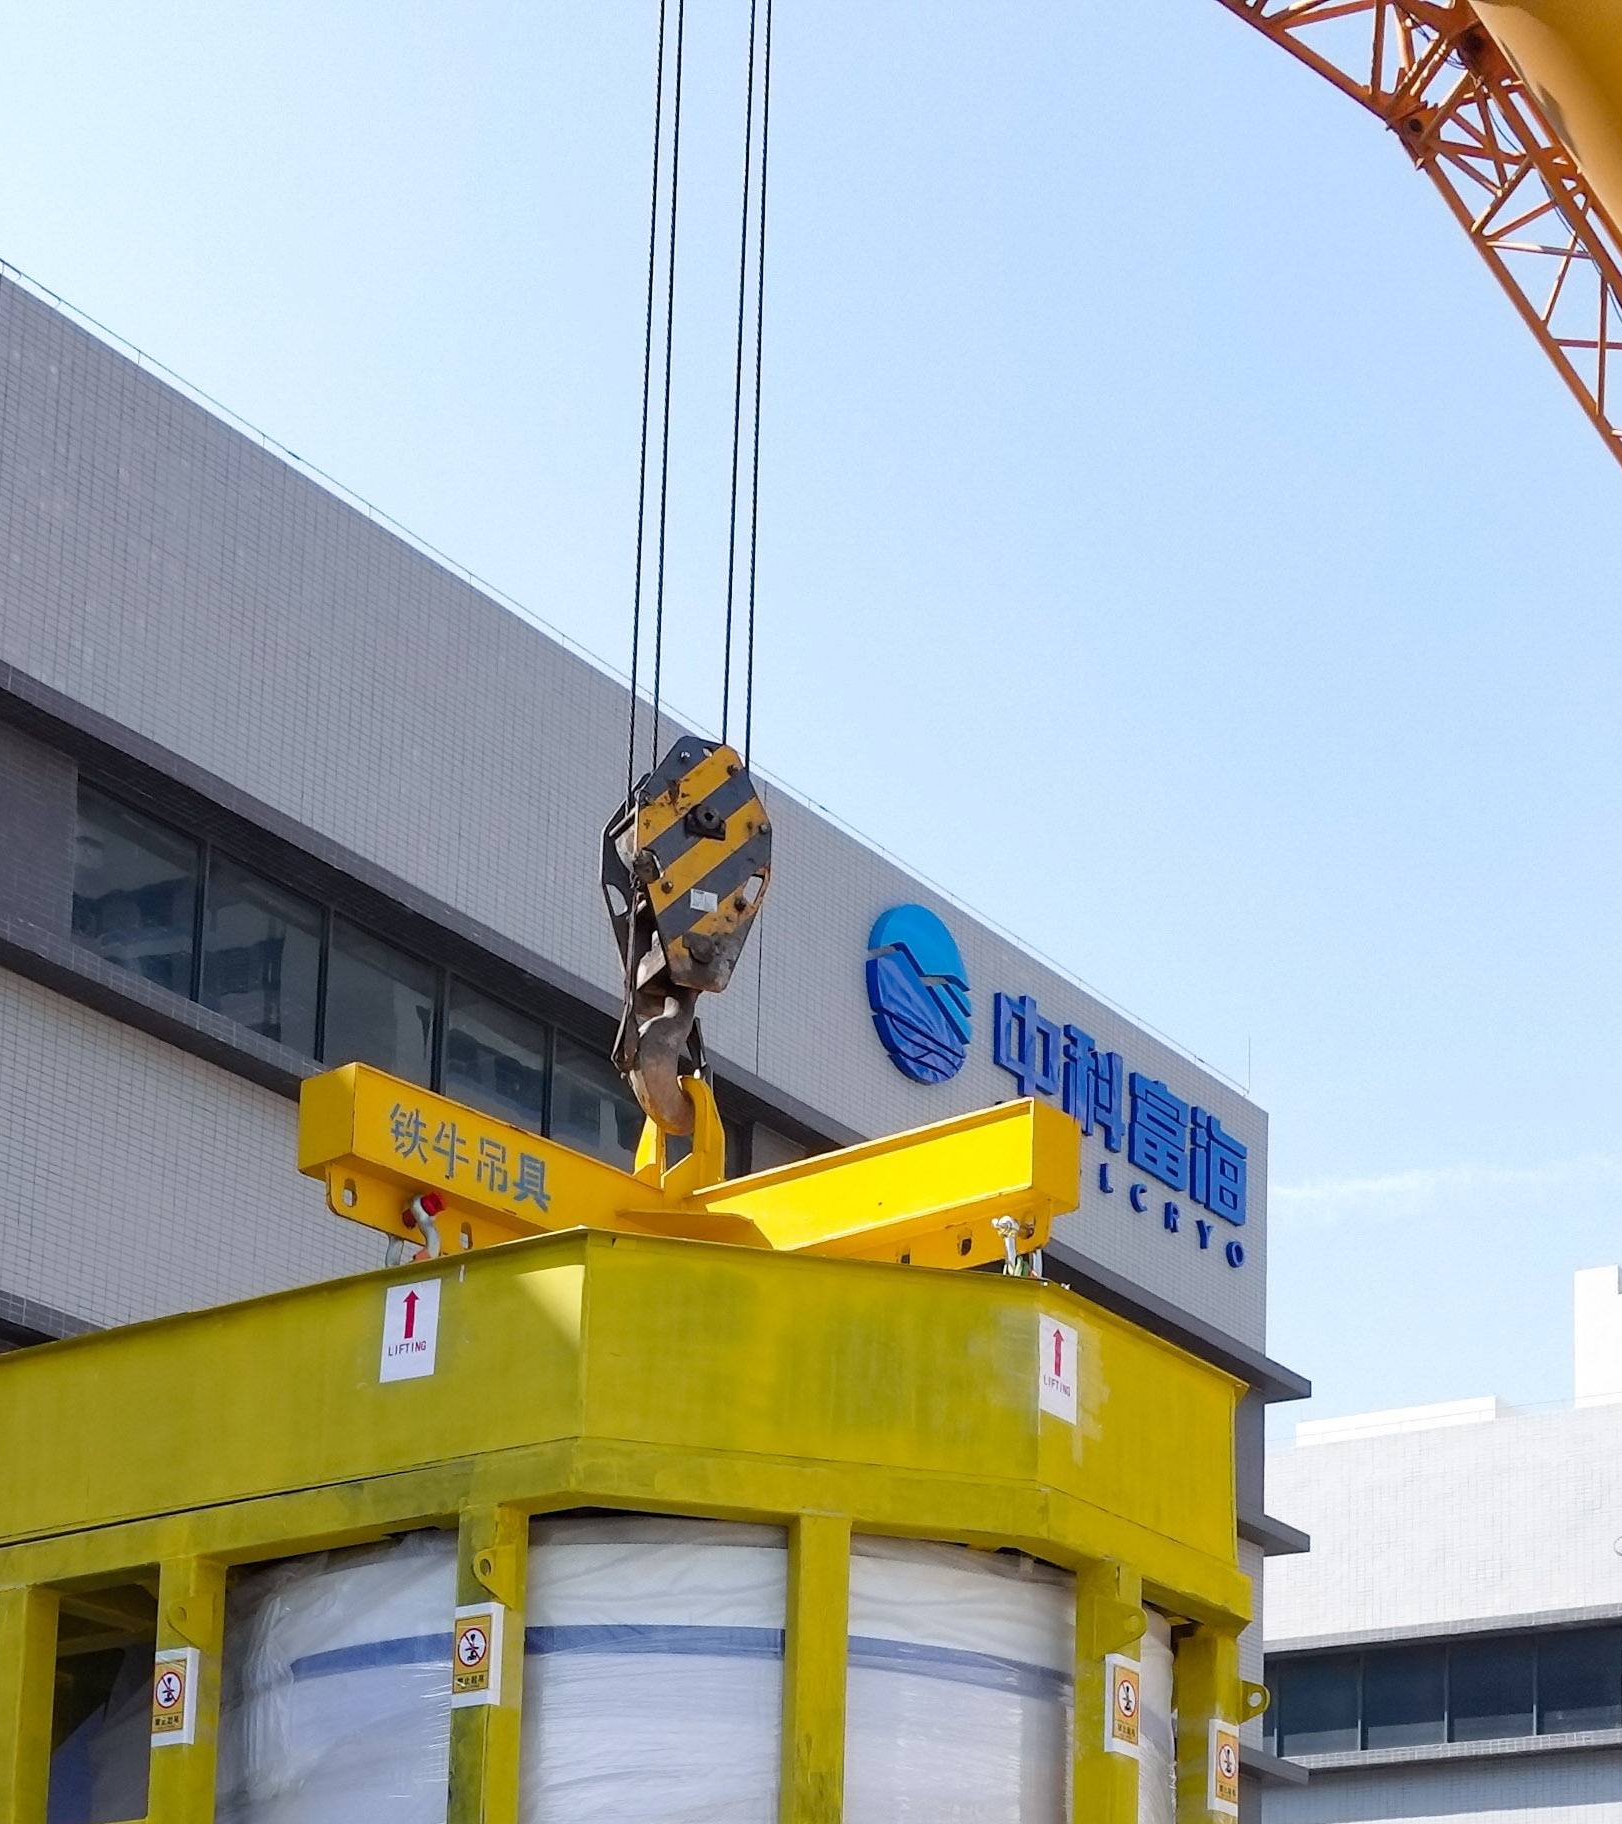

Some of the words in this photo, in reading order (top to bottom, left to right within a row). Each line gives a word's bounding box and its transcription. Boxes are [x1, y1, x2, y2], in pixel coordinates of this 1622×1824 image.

[993, 991, 1248, 1227] 中科富海
[389, 1102, 552, 1213] 铁牛吊具
[387, 1340, 428, 1358] LIFTING
[1042, 1374, 1071, 1398] LIFTING
